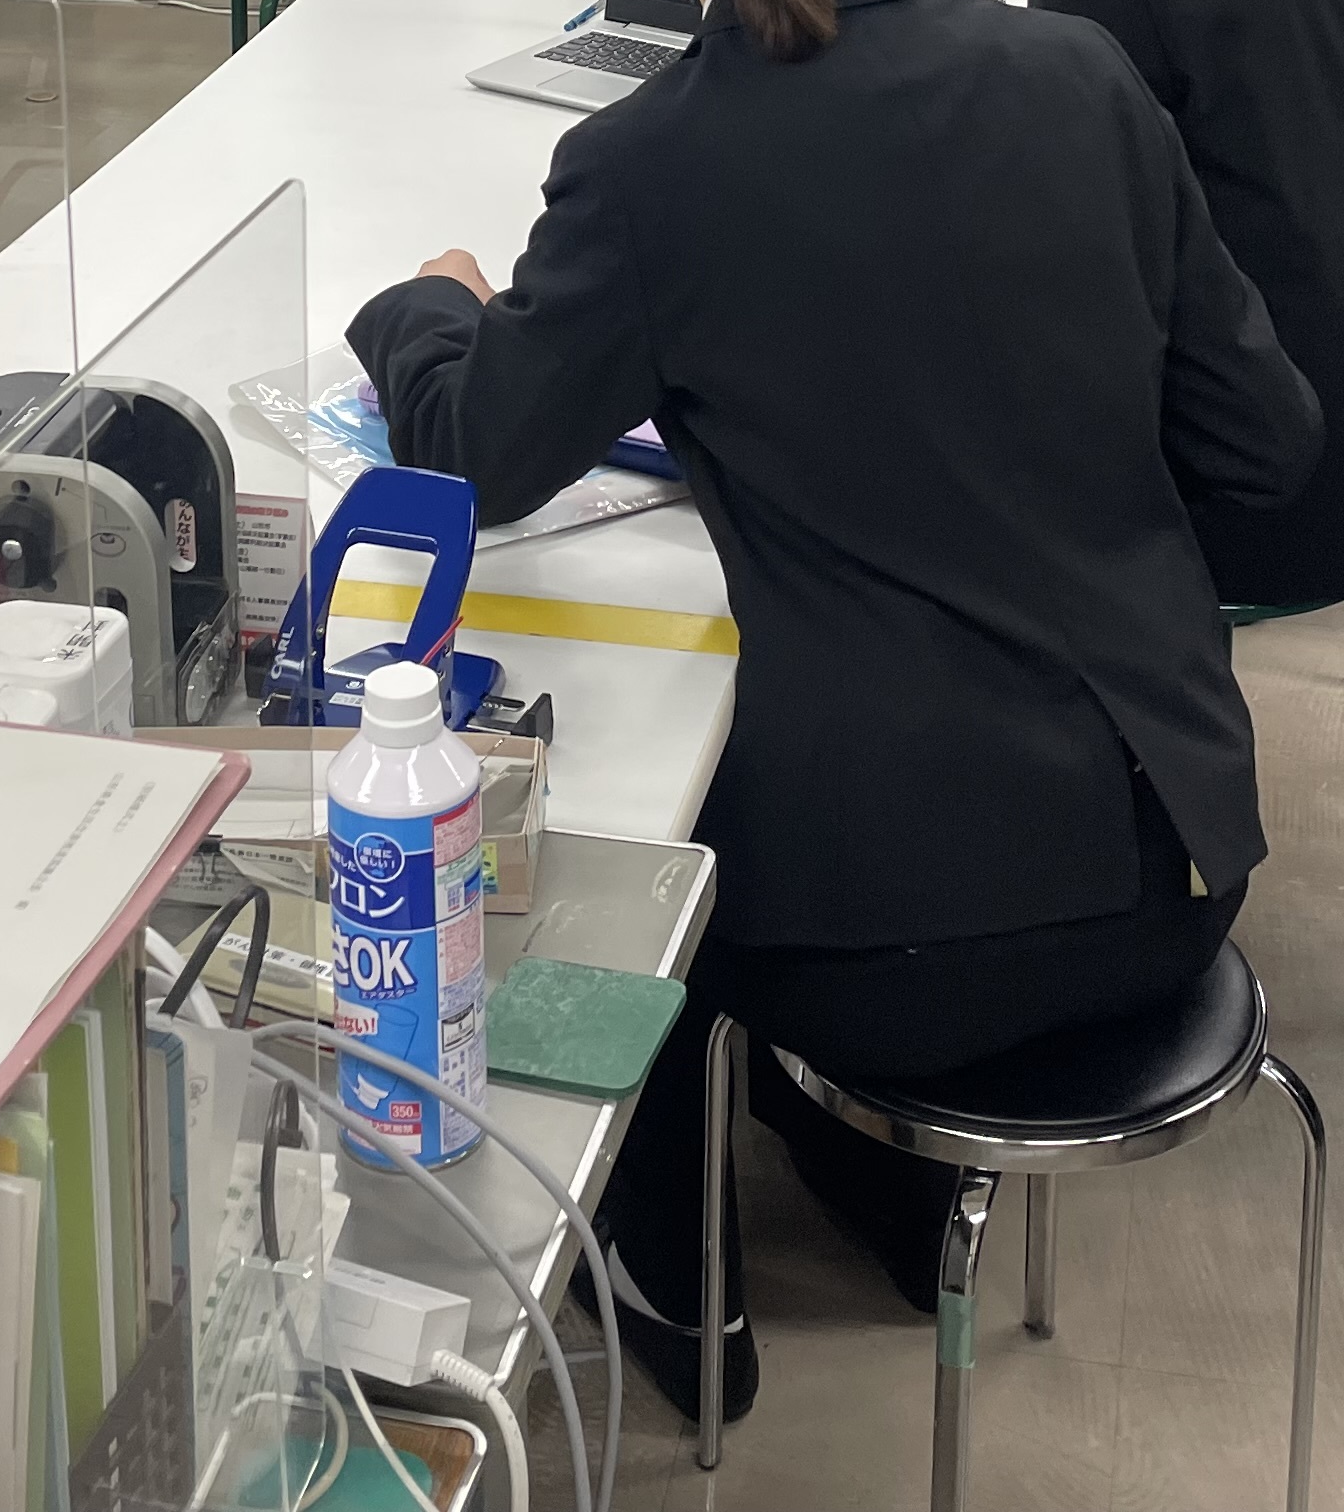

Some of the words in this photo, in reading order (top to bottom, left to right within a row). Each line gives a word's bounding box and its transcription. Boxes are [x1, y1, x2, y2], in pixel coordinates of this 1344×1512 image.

[271, 626, 294, 680] CARL
[360, 988, 416, 1000] エアダスター
